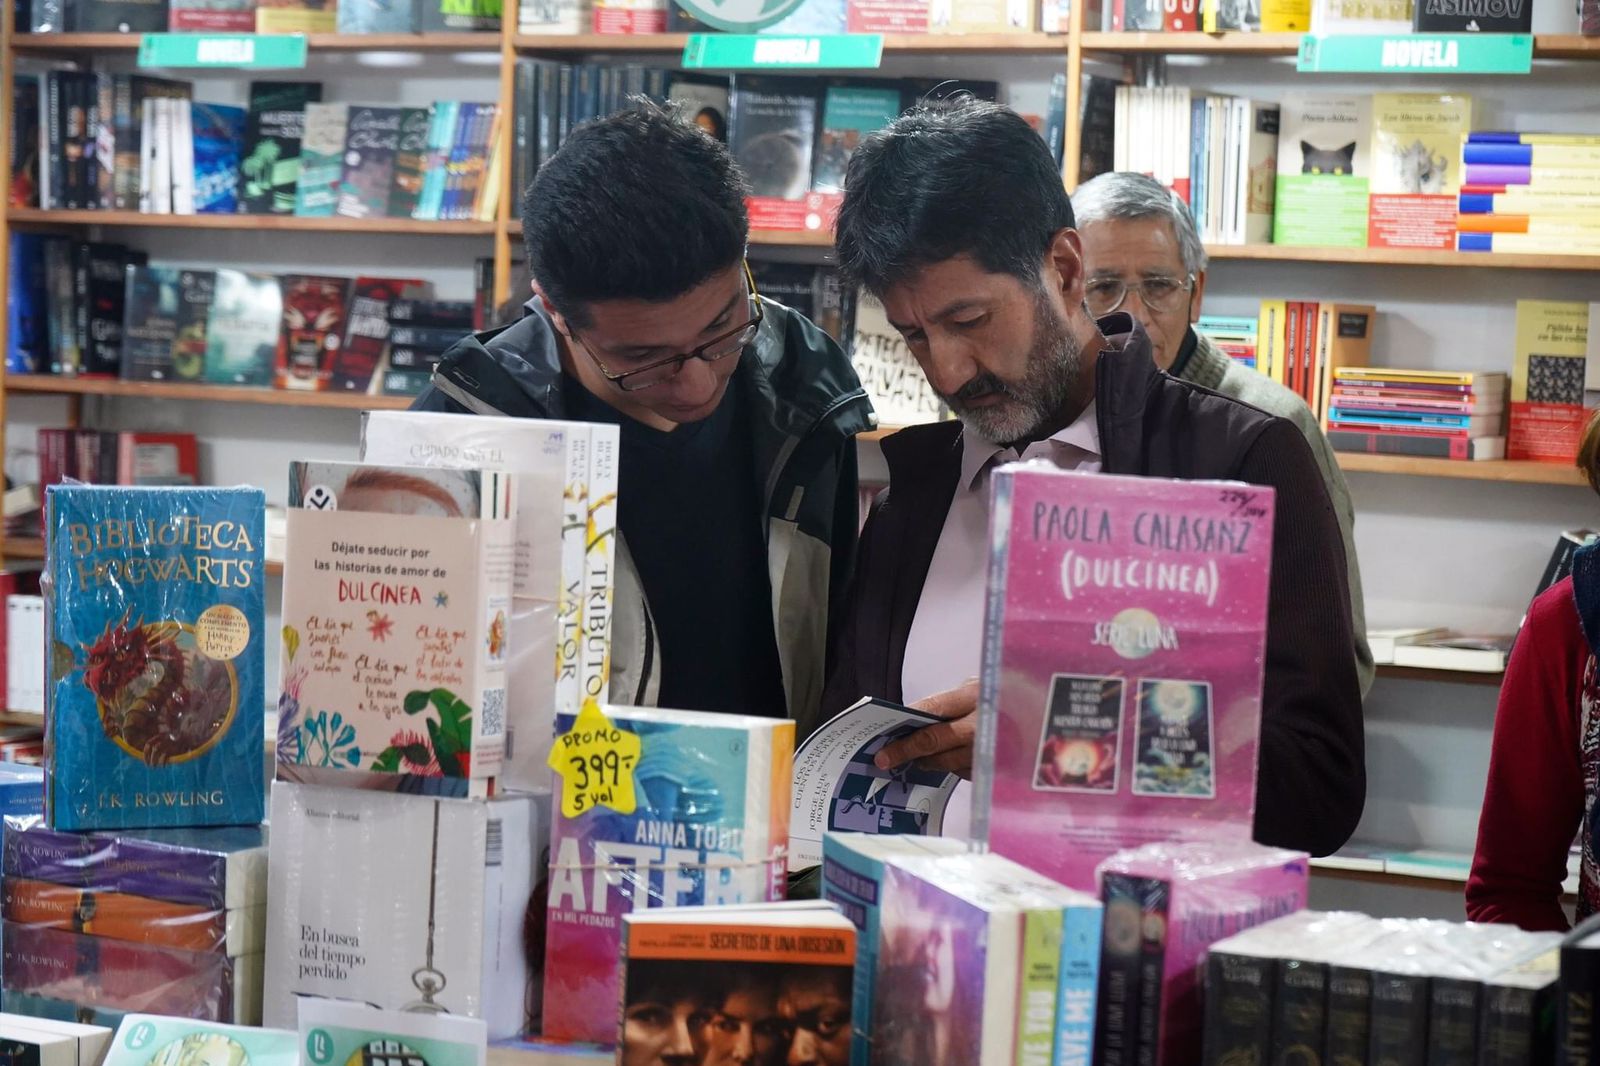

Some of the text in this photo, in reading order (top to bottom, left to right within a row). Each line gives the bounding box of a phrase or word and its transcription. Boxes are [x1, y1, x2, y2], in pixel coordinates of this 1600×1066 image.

[1381, 39, 1458, 67] NOVELA
[69, 516, 254, 557] BIBLIOTECA
[1032, 500, 1253, 554] PAOLA CALASANZ
[331, 541, 430, 559] Déjate seducir por
[76, 554, 254, 592] HOGWARTS
[314, 559, 446, 578] las historias de amor de
[339, 578, 422, 605] DULCINEA
[416, 624, 430, 639] El
[561, 580, 580, 682] VALOR
[586, 563, 608, 696] TRIBUTO
[355, 654, 372, 670] El
[563, 729, 622, 748] PROMO
[839, 741, 857, 760] BIOY
[794, 764, 807, 787] LOS
[804, 730, 839, 765] MEJORES
[794, 756, 818, 809] CUENTOS
[816, 719, 862, 760] POLICIALES
[135, 790, 224, 808] ROWLING
[573, 786, 613, 811] 5 vol
[809, 773, 828, 833] JORGE LUIS
[816, 782, 831, 823] BORGES
[635, 820, 687, 847] ANNA
[33, 846, 68, 860] ROWLING
[547, 836, 745, 913] AFTER
[29, 897, 67, 913] ROWLING
[552, 911, 616, 929] EN MIL PEDAZOS
[301, 924, 360, 948] En busca
[709, 932, 757, 951] SECRETOS
[760, 933, 772, 951] DE
[774, 934, 797, 952] UNA
[797, 934, 846, 954] OBSESIÓN
[31, 955, 70, 970] ROWLING
[299, 944, 367, 969] del tiempo
[299, 963, 348, 981] perdido
[1064, 988, 1093, 1023] ME
[1060, 1030, 1089, 1066] AVE
